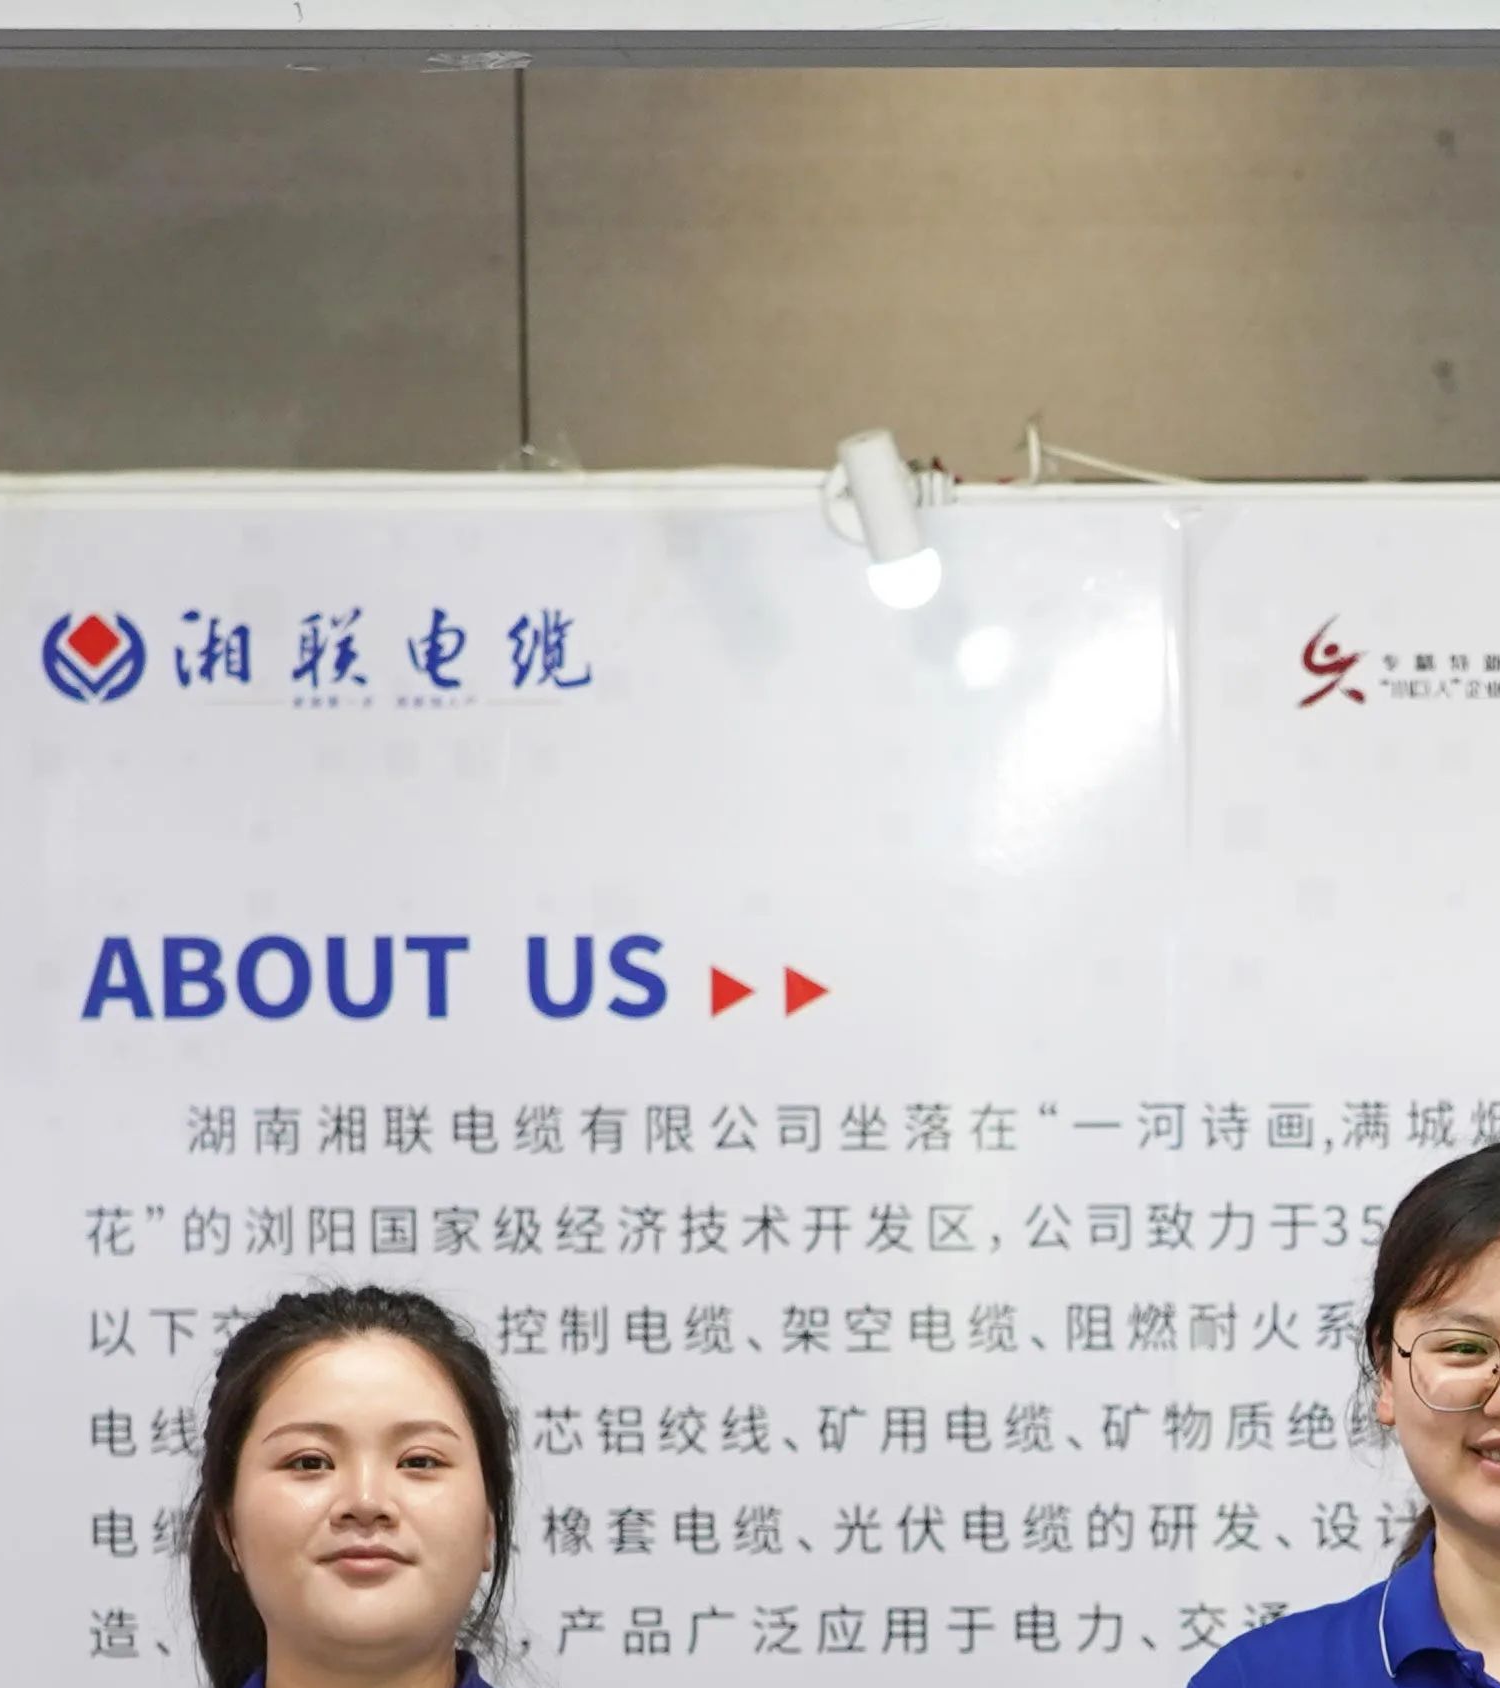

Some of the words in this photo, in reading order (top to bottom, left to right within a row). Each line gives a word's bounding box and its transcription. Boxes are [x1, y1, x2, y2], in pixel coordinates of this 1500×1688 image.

[174, 608, 591, 690] 湘联电缆
[81, 935, 469, 1019] ABOUT
[527, 934, 667, 1019] US
